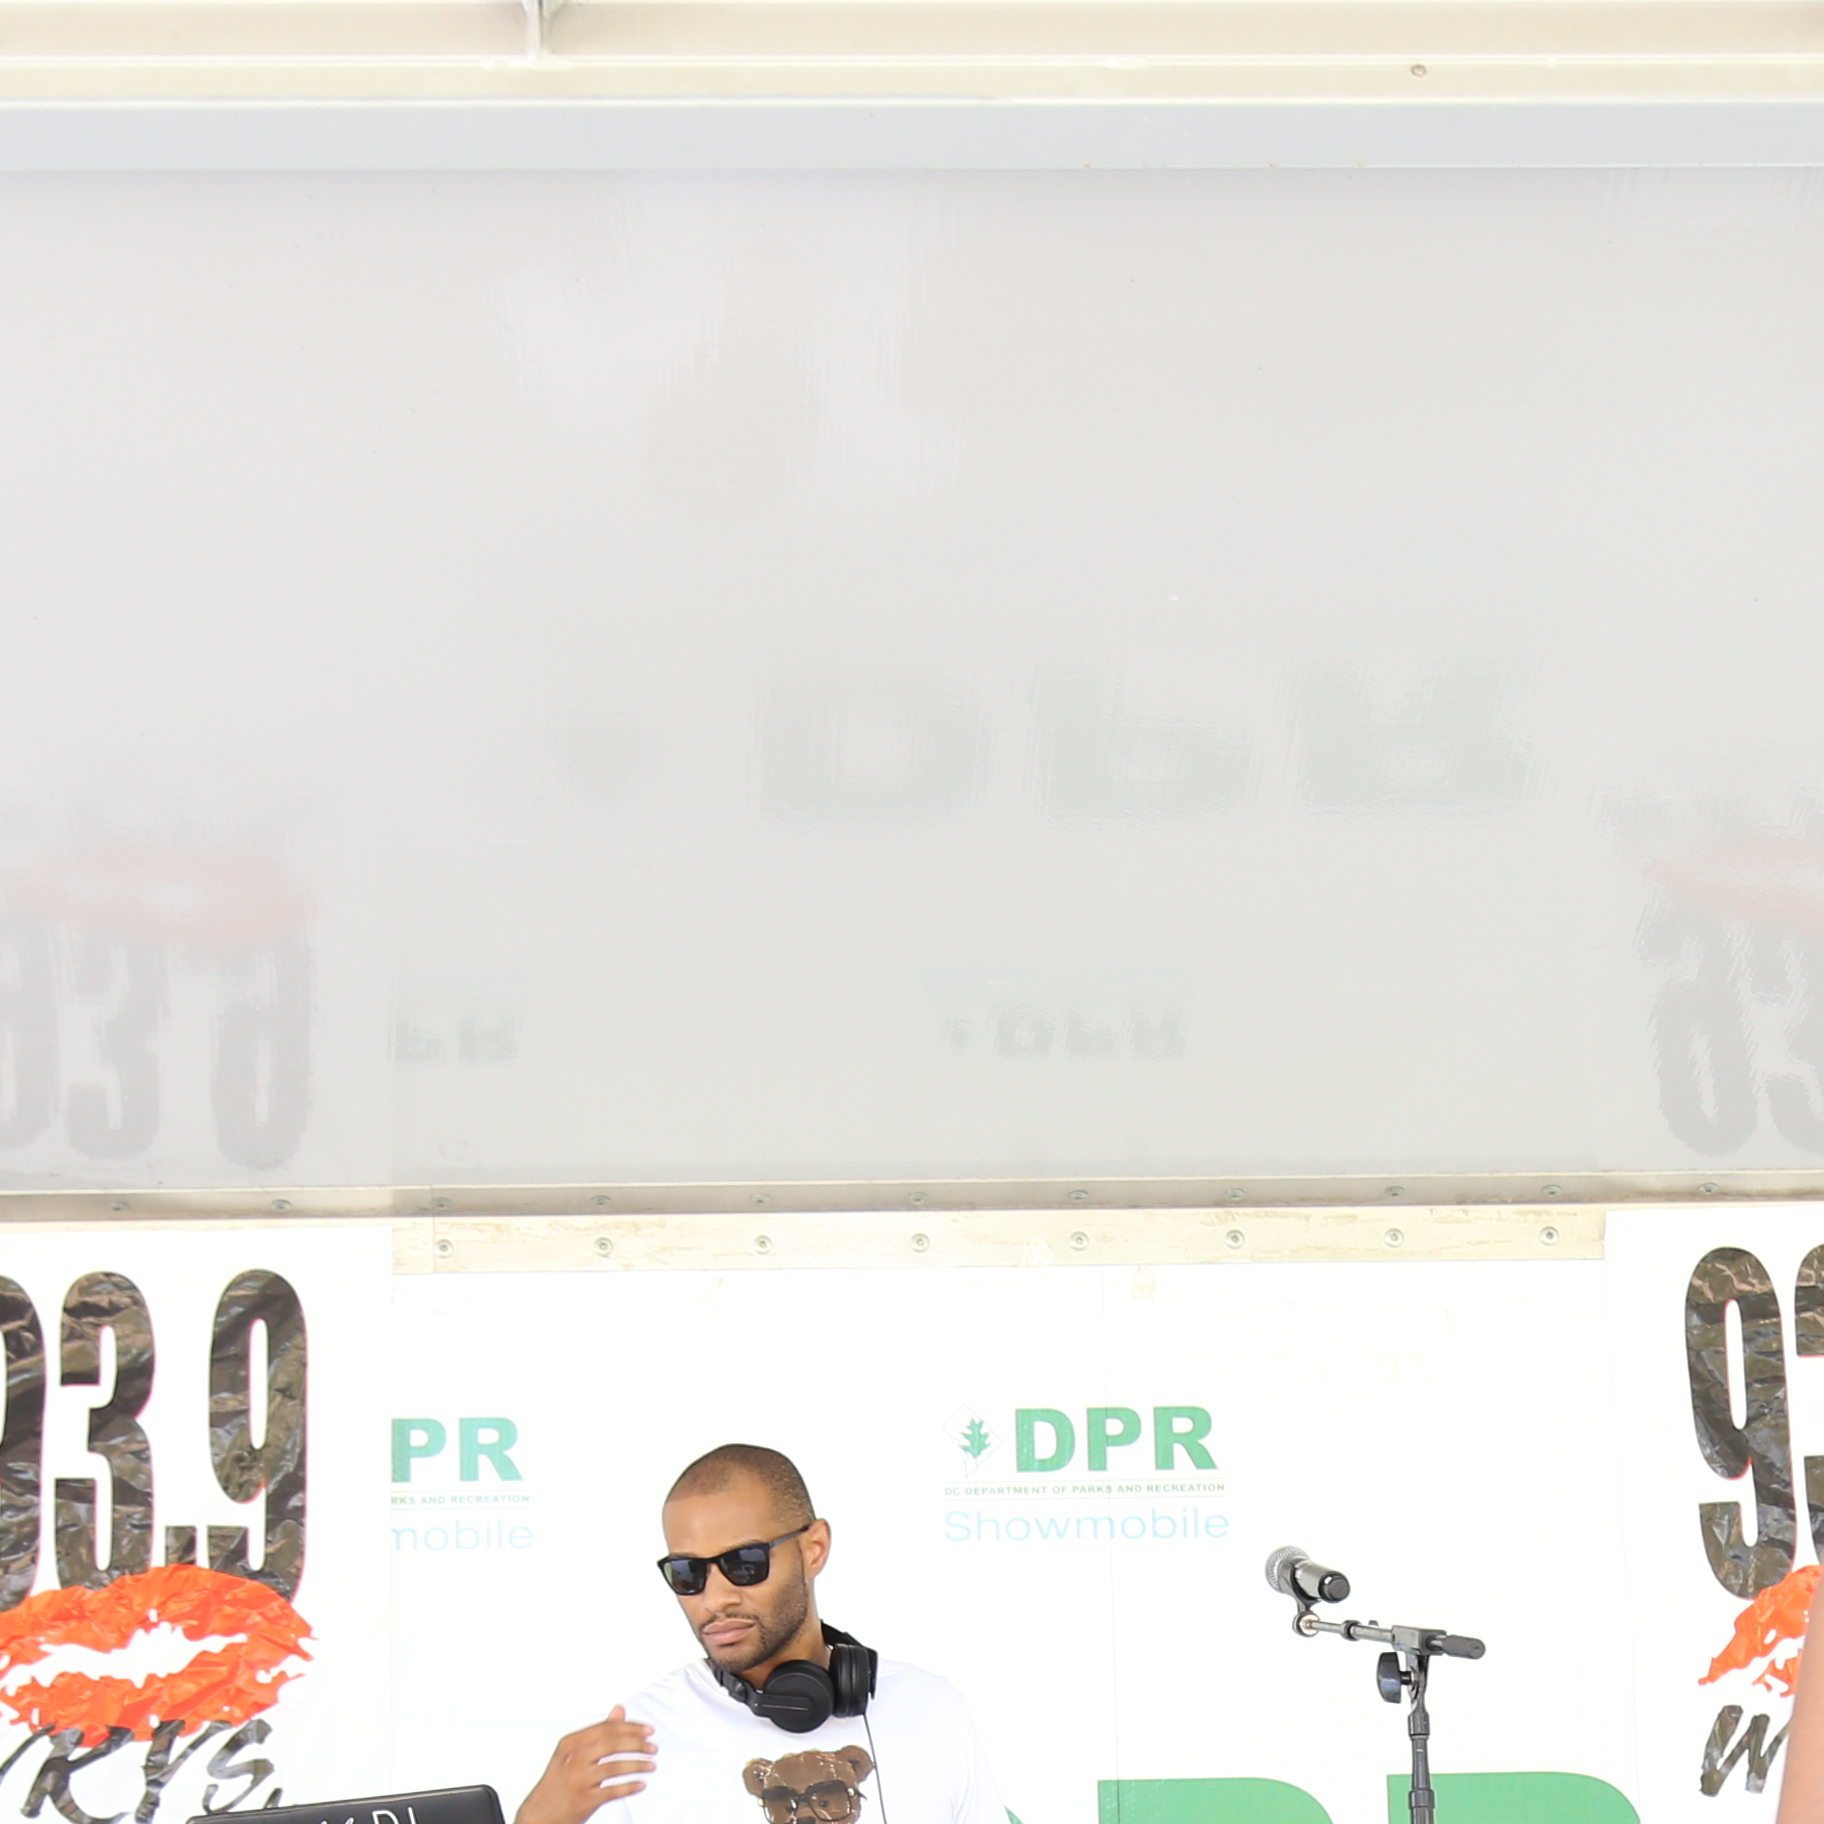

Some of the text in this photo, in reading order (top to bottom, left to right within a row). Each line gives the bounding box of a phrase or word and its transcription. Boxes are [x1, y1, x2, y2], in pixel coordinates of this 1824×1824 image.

[391, 1417, 524, 1483] PR
[1015, 1406, 1218, 1473] DPR
[391, 1494, 530, 1505] RKS AND RECREATION
[945, 1483, 1225, 1496] DC DEPARTMENT OF PARKS AND RECREATION
[391, 1519, 533, 1552] mobile
[945, 1507, 1230, 1542] Showmobile
